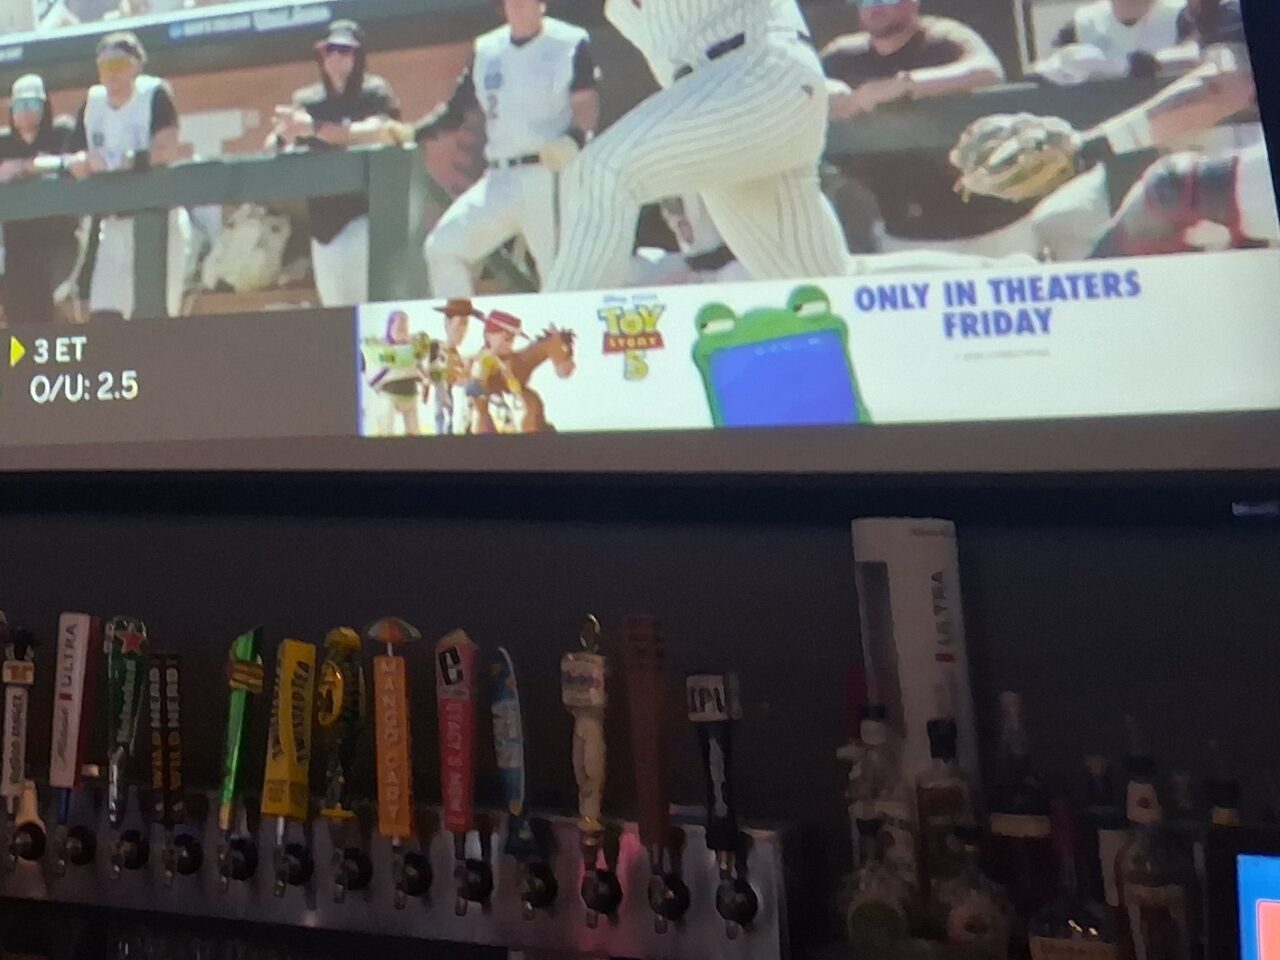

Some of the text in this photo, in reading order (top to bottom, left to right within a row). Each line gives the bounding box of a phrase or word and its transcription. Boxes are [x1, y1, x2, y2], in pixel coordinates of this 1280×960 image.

[854, 269, 1142, 311] ONLY IN THEATERS
[597, 303, 666, 336] TOY
[943, 307, 1052, 339] FRIDAY
[33, 336, 87, 364] 3 ET
[624, 348, 649, 380] 5
[29, 374, 91, 405] O/U:
[96, 370, 139, 400] 2.5
[61, 623, 78, 693] ULTRA
[381, 659, 399, 742] MANGO
